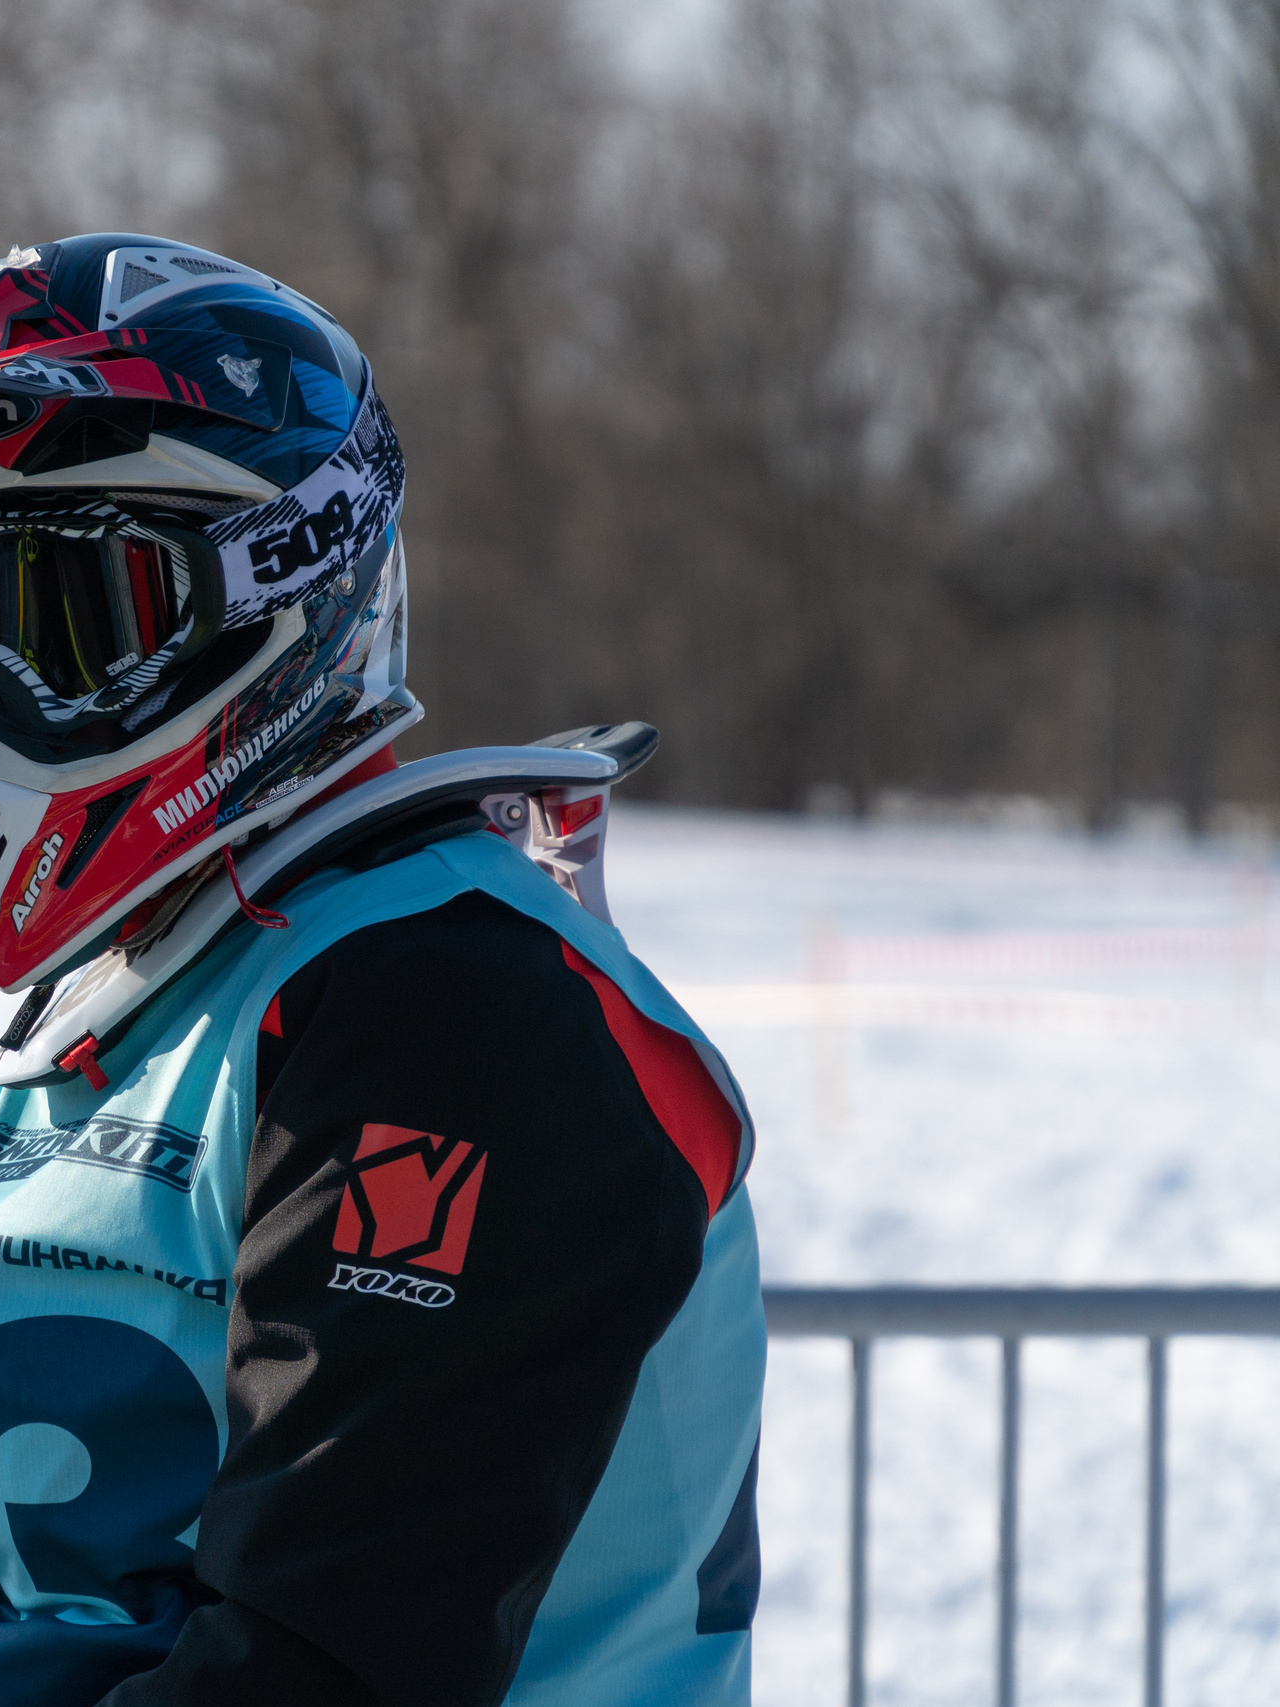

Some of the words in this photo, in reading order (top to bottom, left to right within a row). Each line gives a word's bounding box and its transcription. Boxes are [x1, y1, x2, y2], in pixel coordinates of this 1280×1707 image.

[248, 490, 354, 584] 509
[105, 652, 139, 676] 509
[152, 673, 326, 835] МИЛЮЩЕНКОВ
[327, 1263, 456, 1308] YOKO
